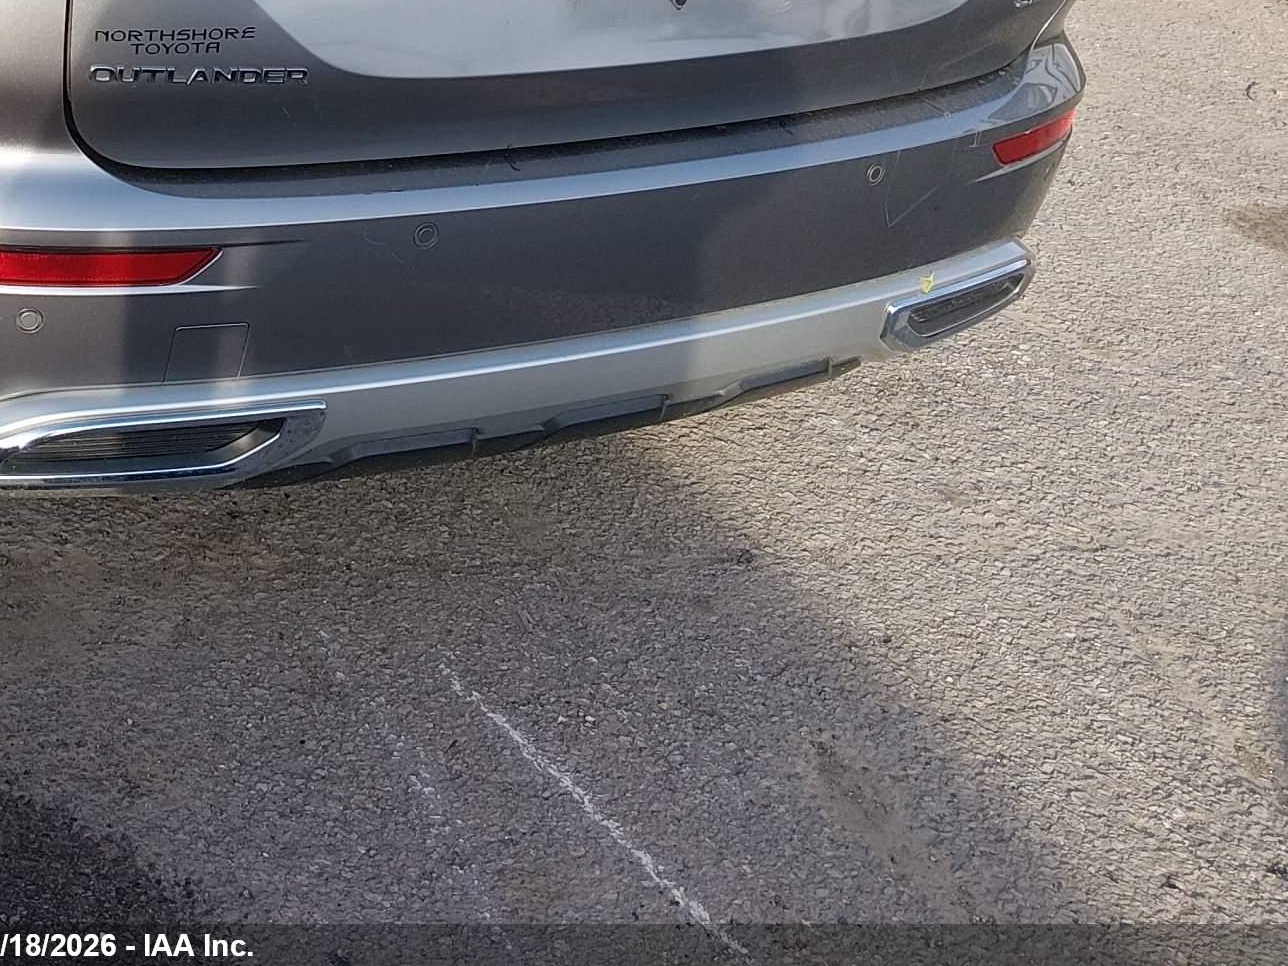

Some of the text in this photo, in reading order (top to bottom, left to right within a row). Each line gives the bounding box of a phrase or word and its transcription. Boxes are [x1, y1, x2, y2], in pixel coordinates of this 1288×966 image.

[94, 26, 256, 43] NORTHSHORE
[131, 41, 221, 55] TOYOTA
[89, 64, 309, 86] OUTLANDER
